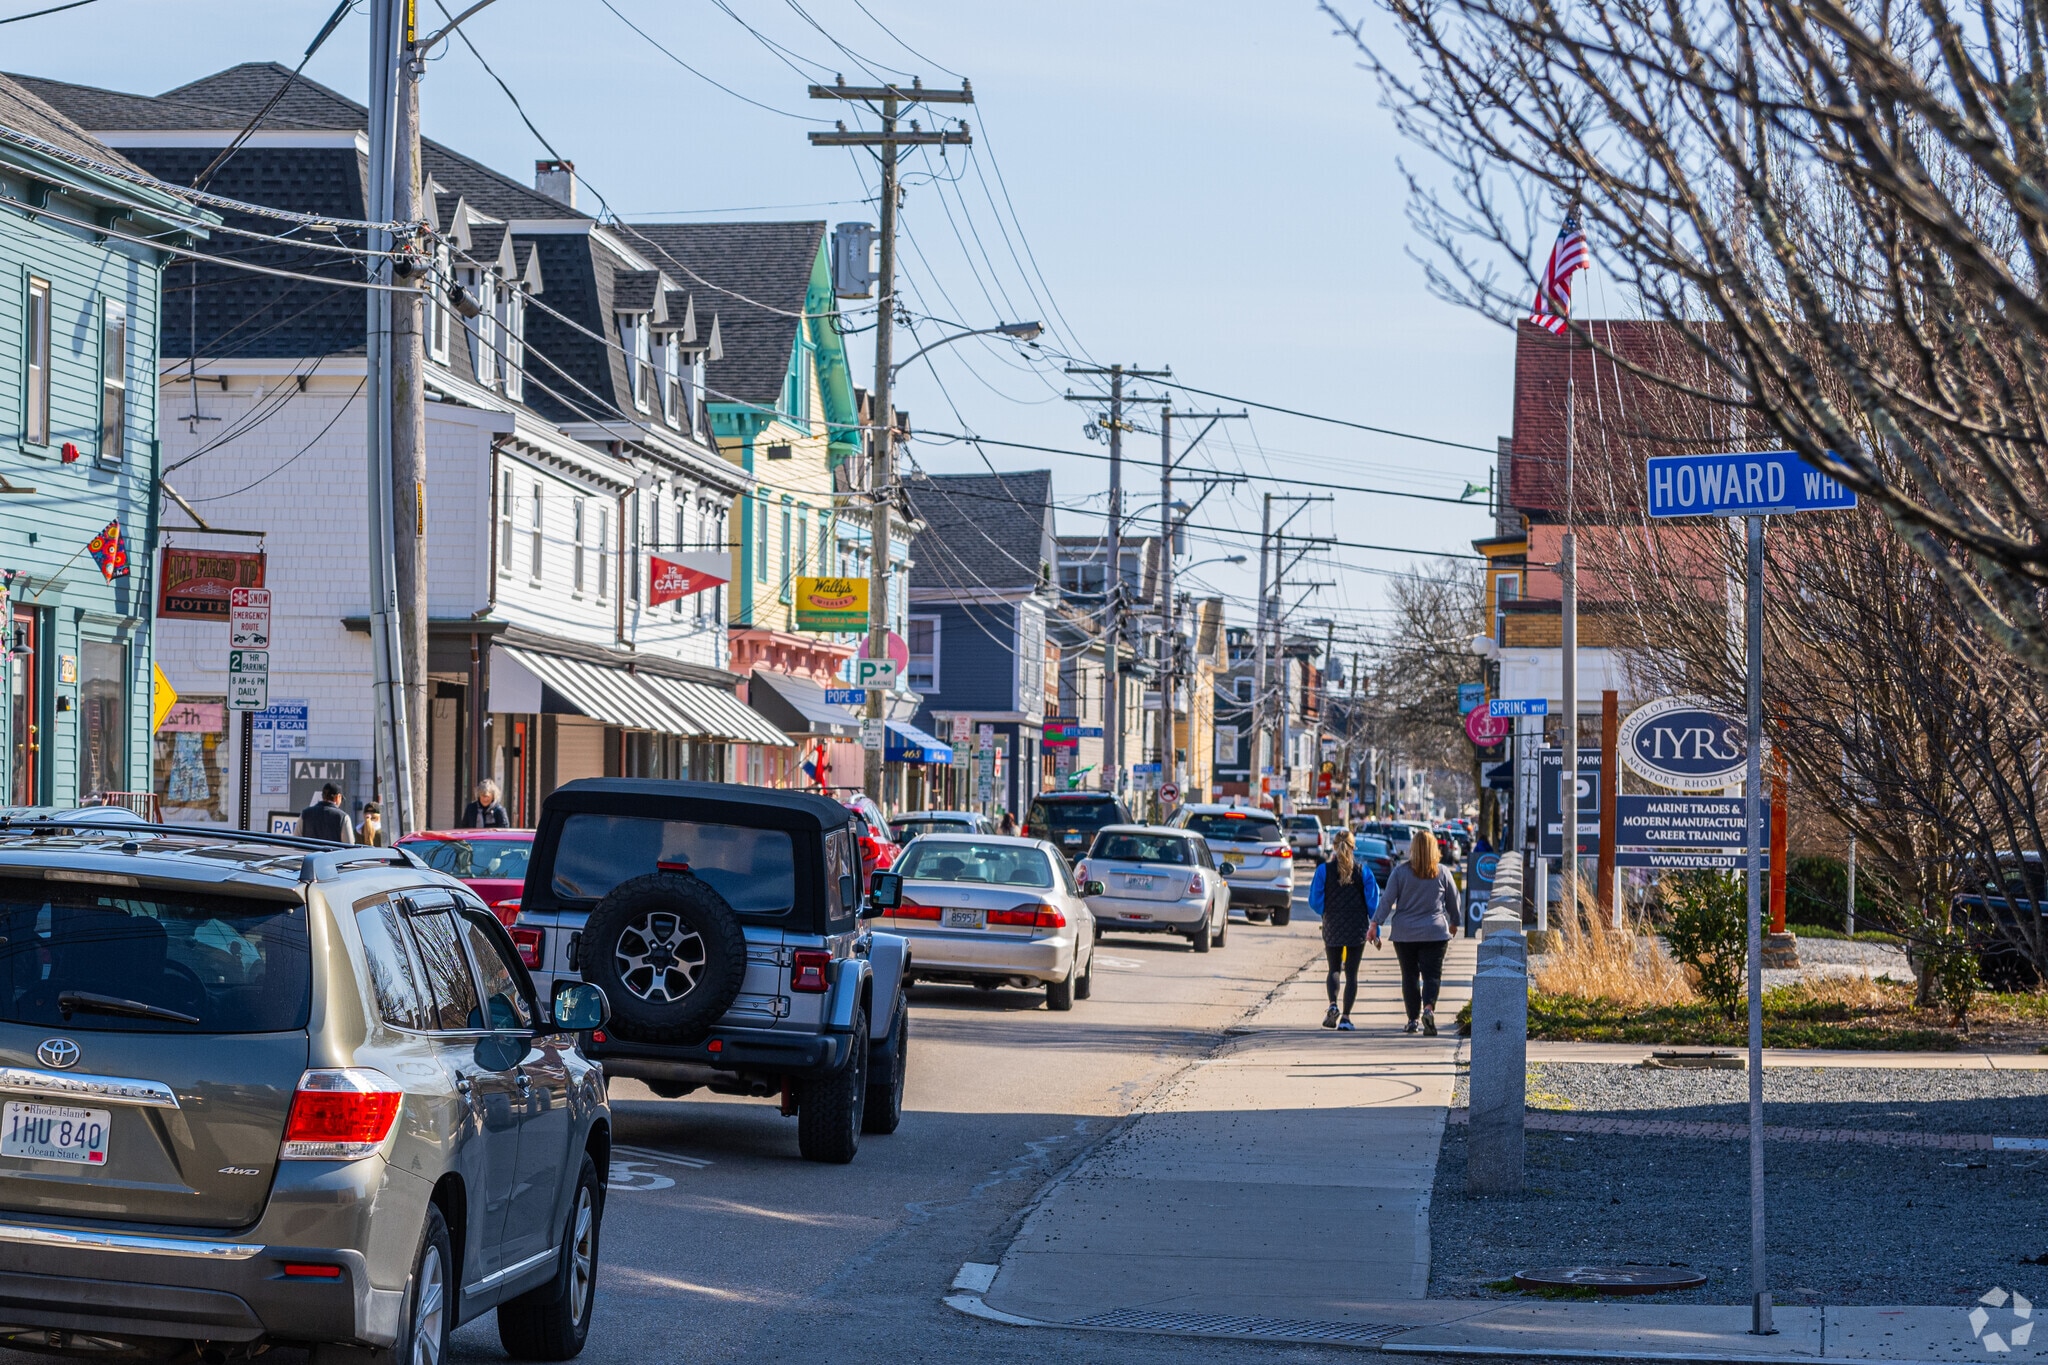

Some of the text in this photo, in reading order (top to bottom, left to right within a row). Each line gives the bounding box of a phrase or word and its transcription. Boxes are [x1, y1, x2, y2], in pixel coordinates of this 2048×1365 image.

[1654, 461, 1786, 508] HOWARD
[166, 555, 258, 592] ALL FIRED UP
[667, 566, 677, 575] 12
[654, 579, 690, 590] CAFE
[813, 578, 853, 597] Wally's
[249, 593, 269, 604] SNOW
[170, 599, 229, 613] POTTE
[234, 611, 268, 621] EMERGENCY
[240, 623, 260, 631] ROUTE
[231, 654, 260, 670] 2 HR
[242, 663, 267, 672] PARKING
[231, 676, 236, 685] 8
[257, 677, 265, 686] PM
[238, 687, 258, 696] DAILY
[827, 690, 863, 703] POPE ST
[279, 706, 303, 715] PARK
[1491, 700, 1527, 715] SPRING
[1531, 704, 1545, 713] WHF
[161, 707, 201, 726] arth
[253, 721, 305, 729] EXT SCAN
[863, 720, 869, 729] 2
[1621, 711, 1651, 747] SCHOOL
[1650, 701, 1664, 713] OF
[1063, 727, 1095, 737] EXTENSION
[1652, 727, 1740, 760] IYRS
[1543, 756, 1563, 765] PUBL
[297, 762, 343, 779] ATM
[1627, 756, 1746, 788] NEWPORT, RHODE ISL
[1647, 803, 1741, 815] MARINE TRADES &
[1623, 816, 1765, 829] MODERN MANUFACTURIG
[1645, 830, 1741, 842] CAREER TRAINING
[1649, 855, 1736, 867] WWW.IYRS.EDU
[29, 1104, 86, 1119] Rhode Island
[12, 1115, 101, 1149] 1HU 840
[27, 1145, 55, 1157] Ocean
[57, 1148, 80, 1159] State
[218, 1166, 260, 1176] 4WD
